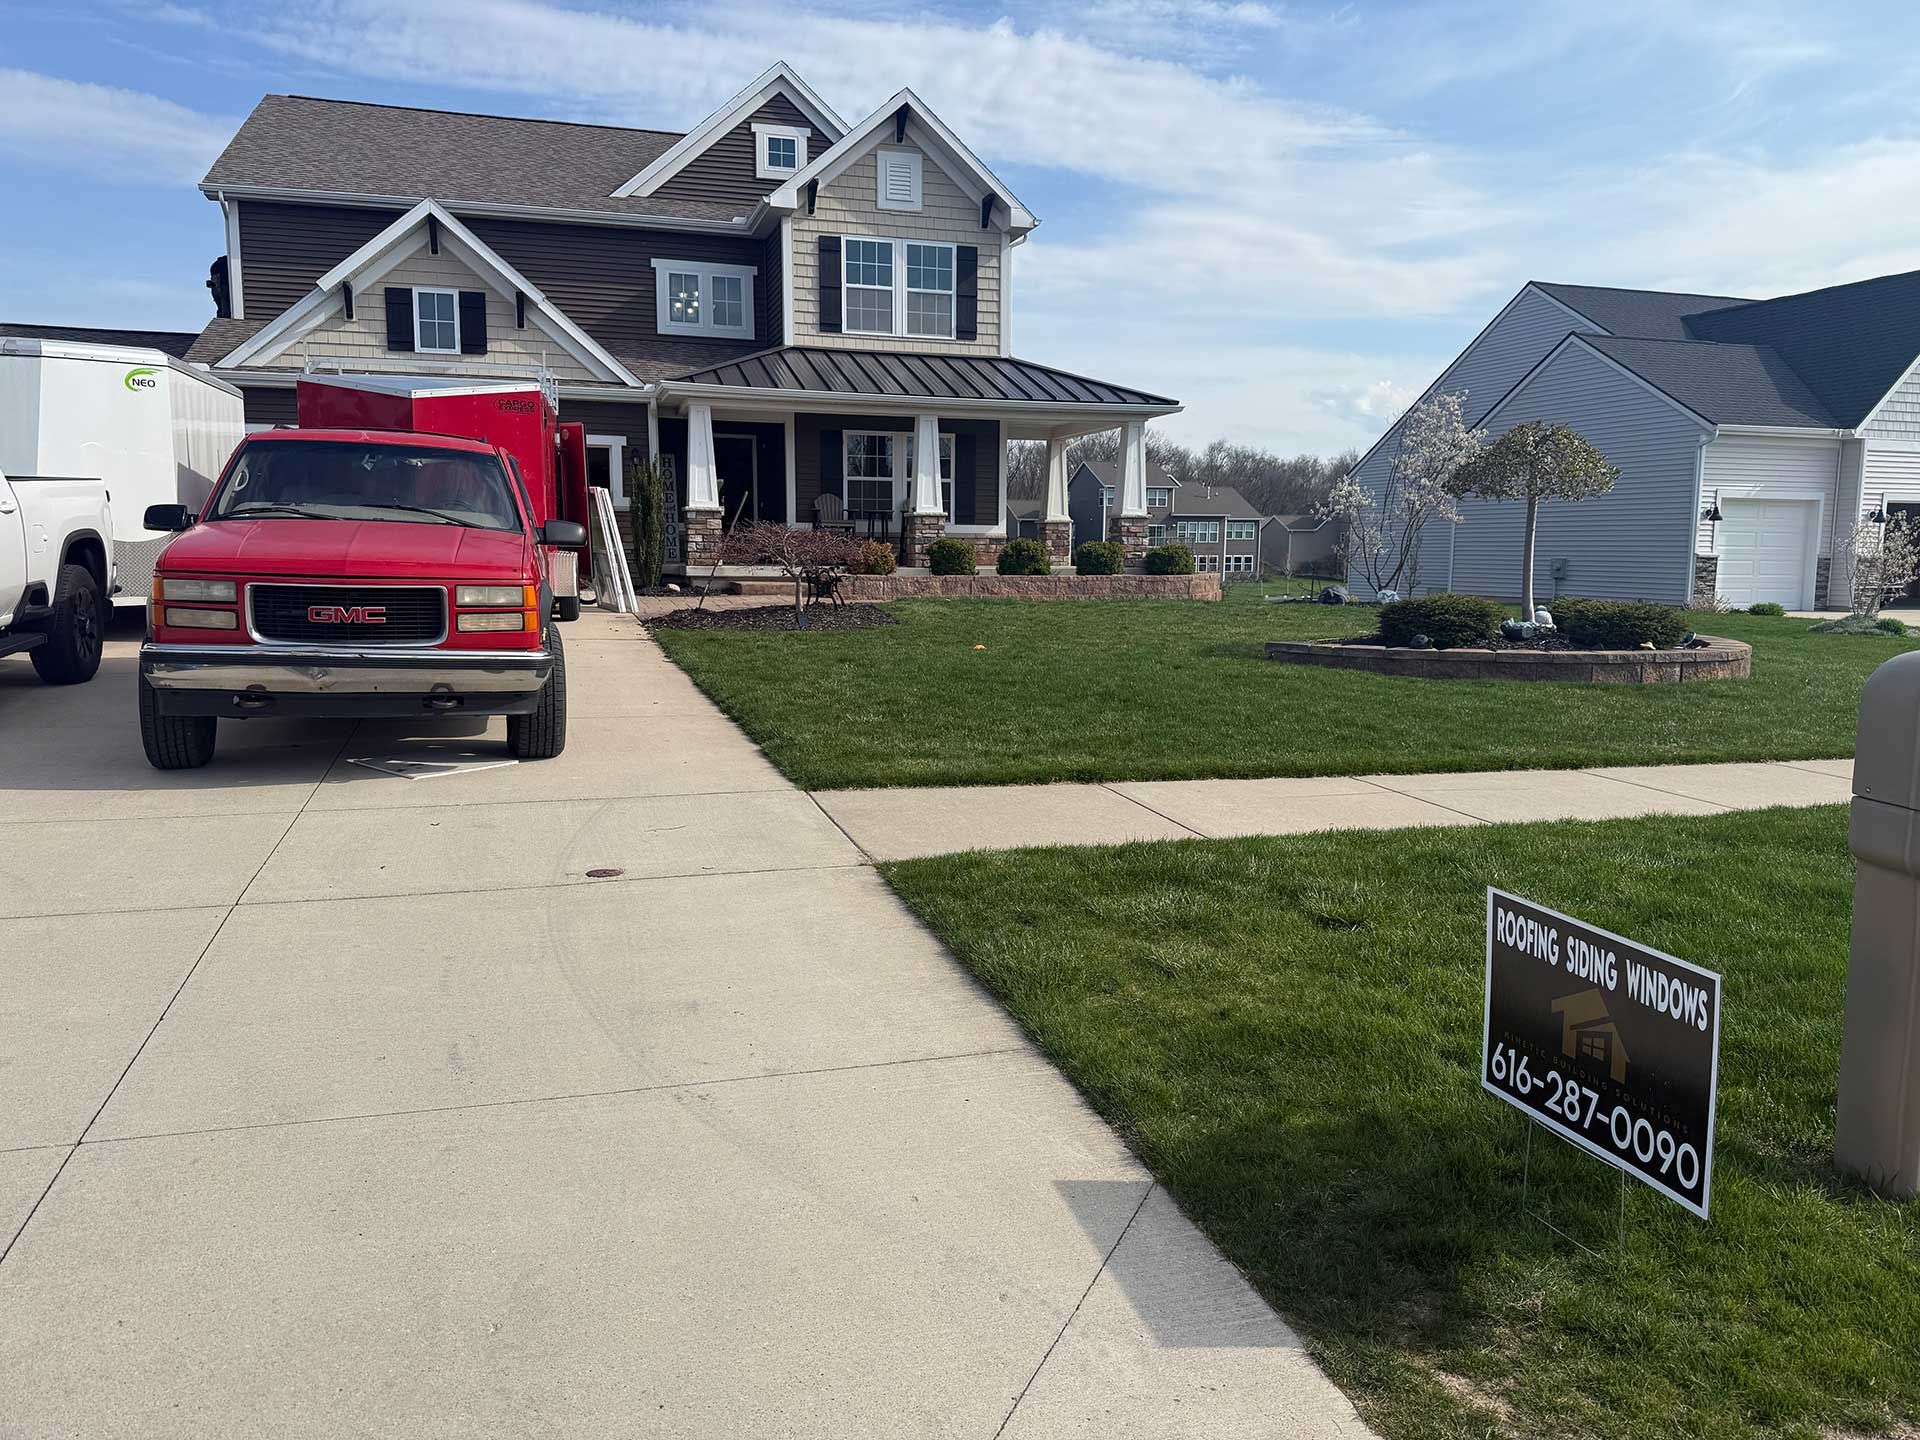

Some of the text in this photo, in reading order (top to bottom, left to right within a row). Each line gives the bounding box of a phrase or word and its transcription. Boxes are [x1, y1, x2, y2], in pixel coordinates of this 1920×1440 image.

[132, 378, 156, 388] NEO
[498, 399, 535, 408] CARGO
[308, 606, 386, 623] GMC
[1497, 907, 1709, 1032] ROOFING SIDING WINDOWS
[1491, 1042, 1700, 1190] 616-287-0090
[1552, 1056, 1608, 1091] BUILDING
[1615, 1089, 1690, 1134] SOLUTIONS
